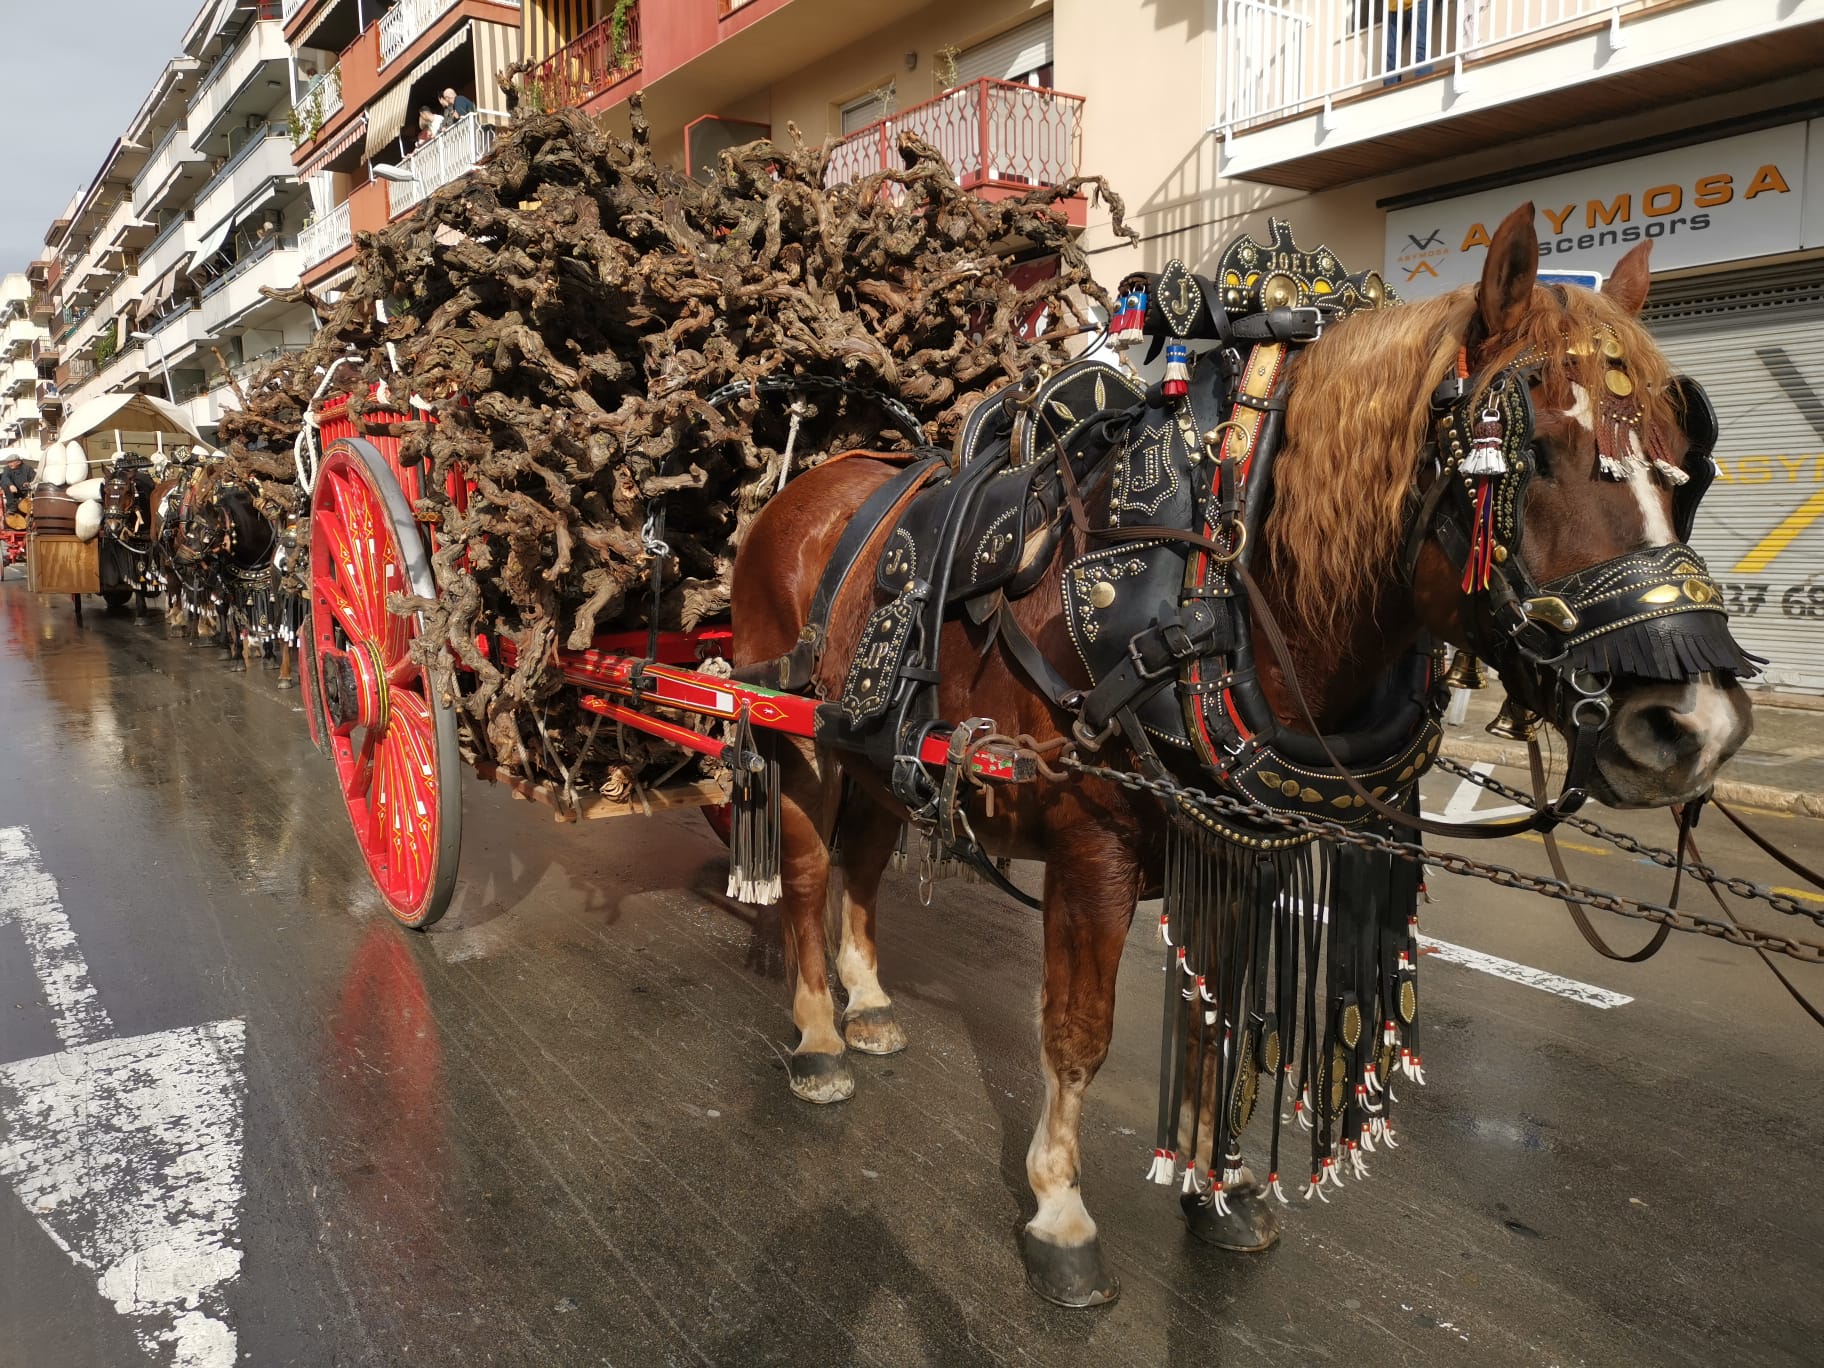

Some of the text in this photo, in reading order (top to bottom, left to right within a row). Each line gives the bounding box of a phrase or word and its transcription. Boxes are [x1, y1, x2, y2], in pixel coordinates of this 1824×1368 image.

[1460, 164, 1790, 252] AYMOSA
[1538, 213, 1712, 257] scensors
[1266, 251, 1316, 274] JOEL
[1172, 279, 1188, 315] J
[1714, 453, 1824, 485] ASY
[886, 549, 903, 575] J
[988, 534, 1005, 564] P
[1717, 583, 1769, 617] 37
[862, 642, 888, 668] JP
